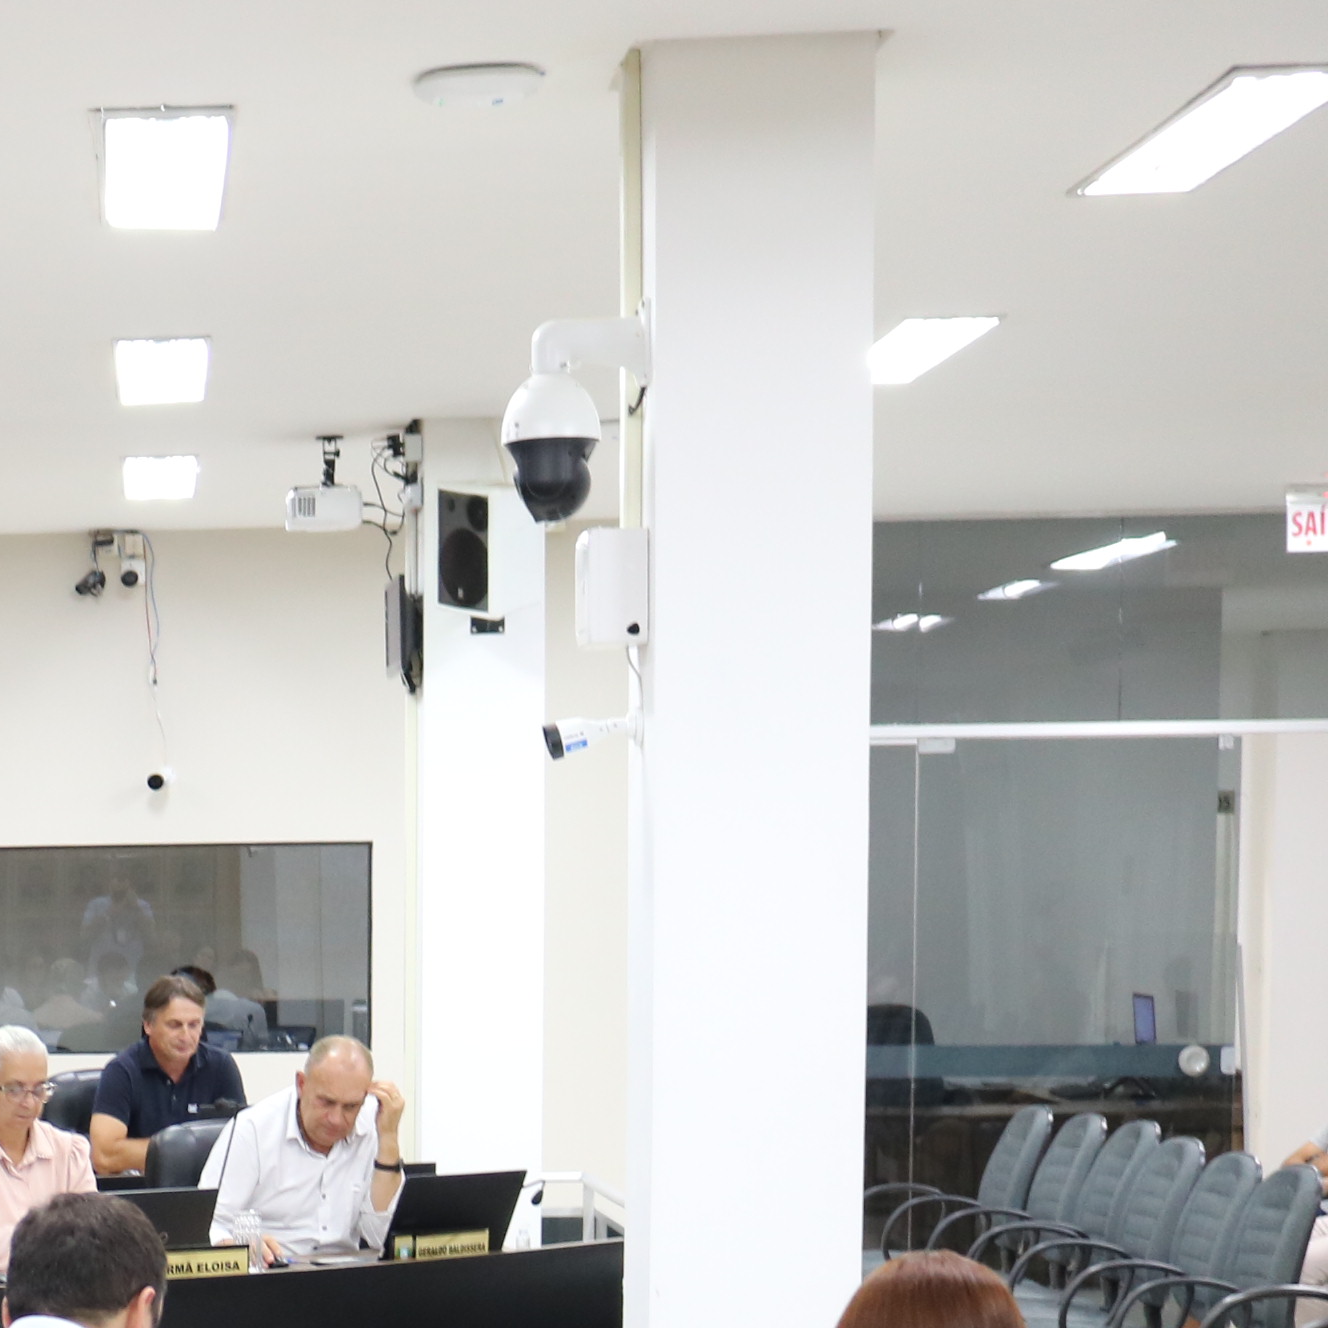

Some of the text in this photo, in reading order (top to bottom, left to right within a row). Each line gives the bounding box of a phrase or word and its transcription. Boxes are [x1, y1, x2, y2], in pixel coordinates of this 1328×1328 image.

[1291, 503, 1327, 537] SAÍ
[167, 1260, 240, 1275] RMÃ ELOISA
